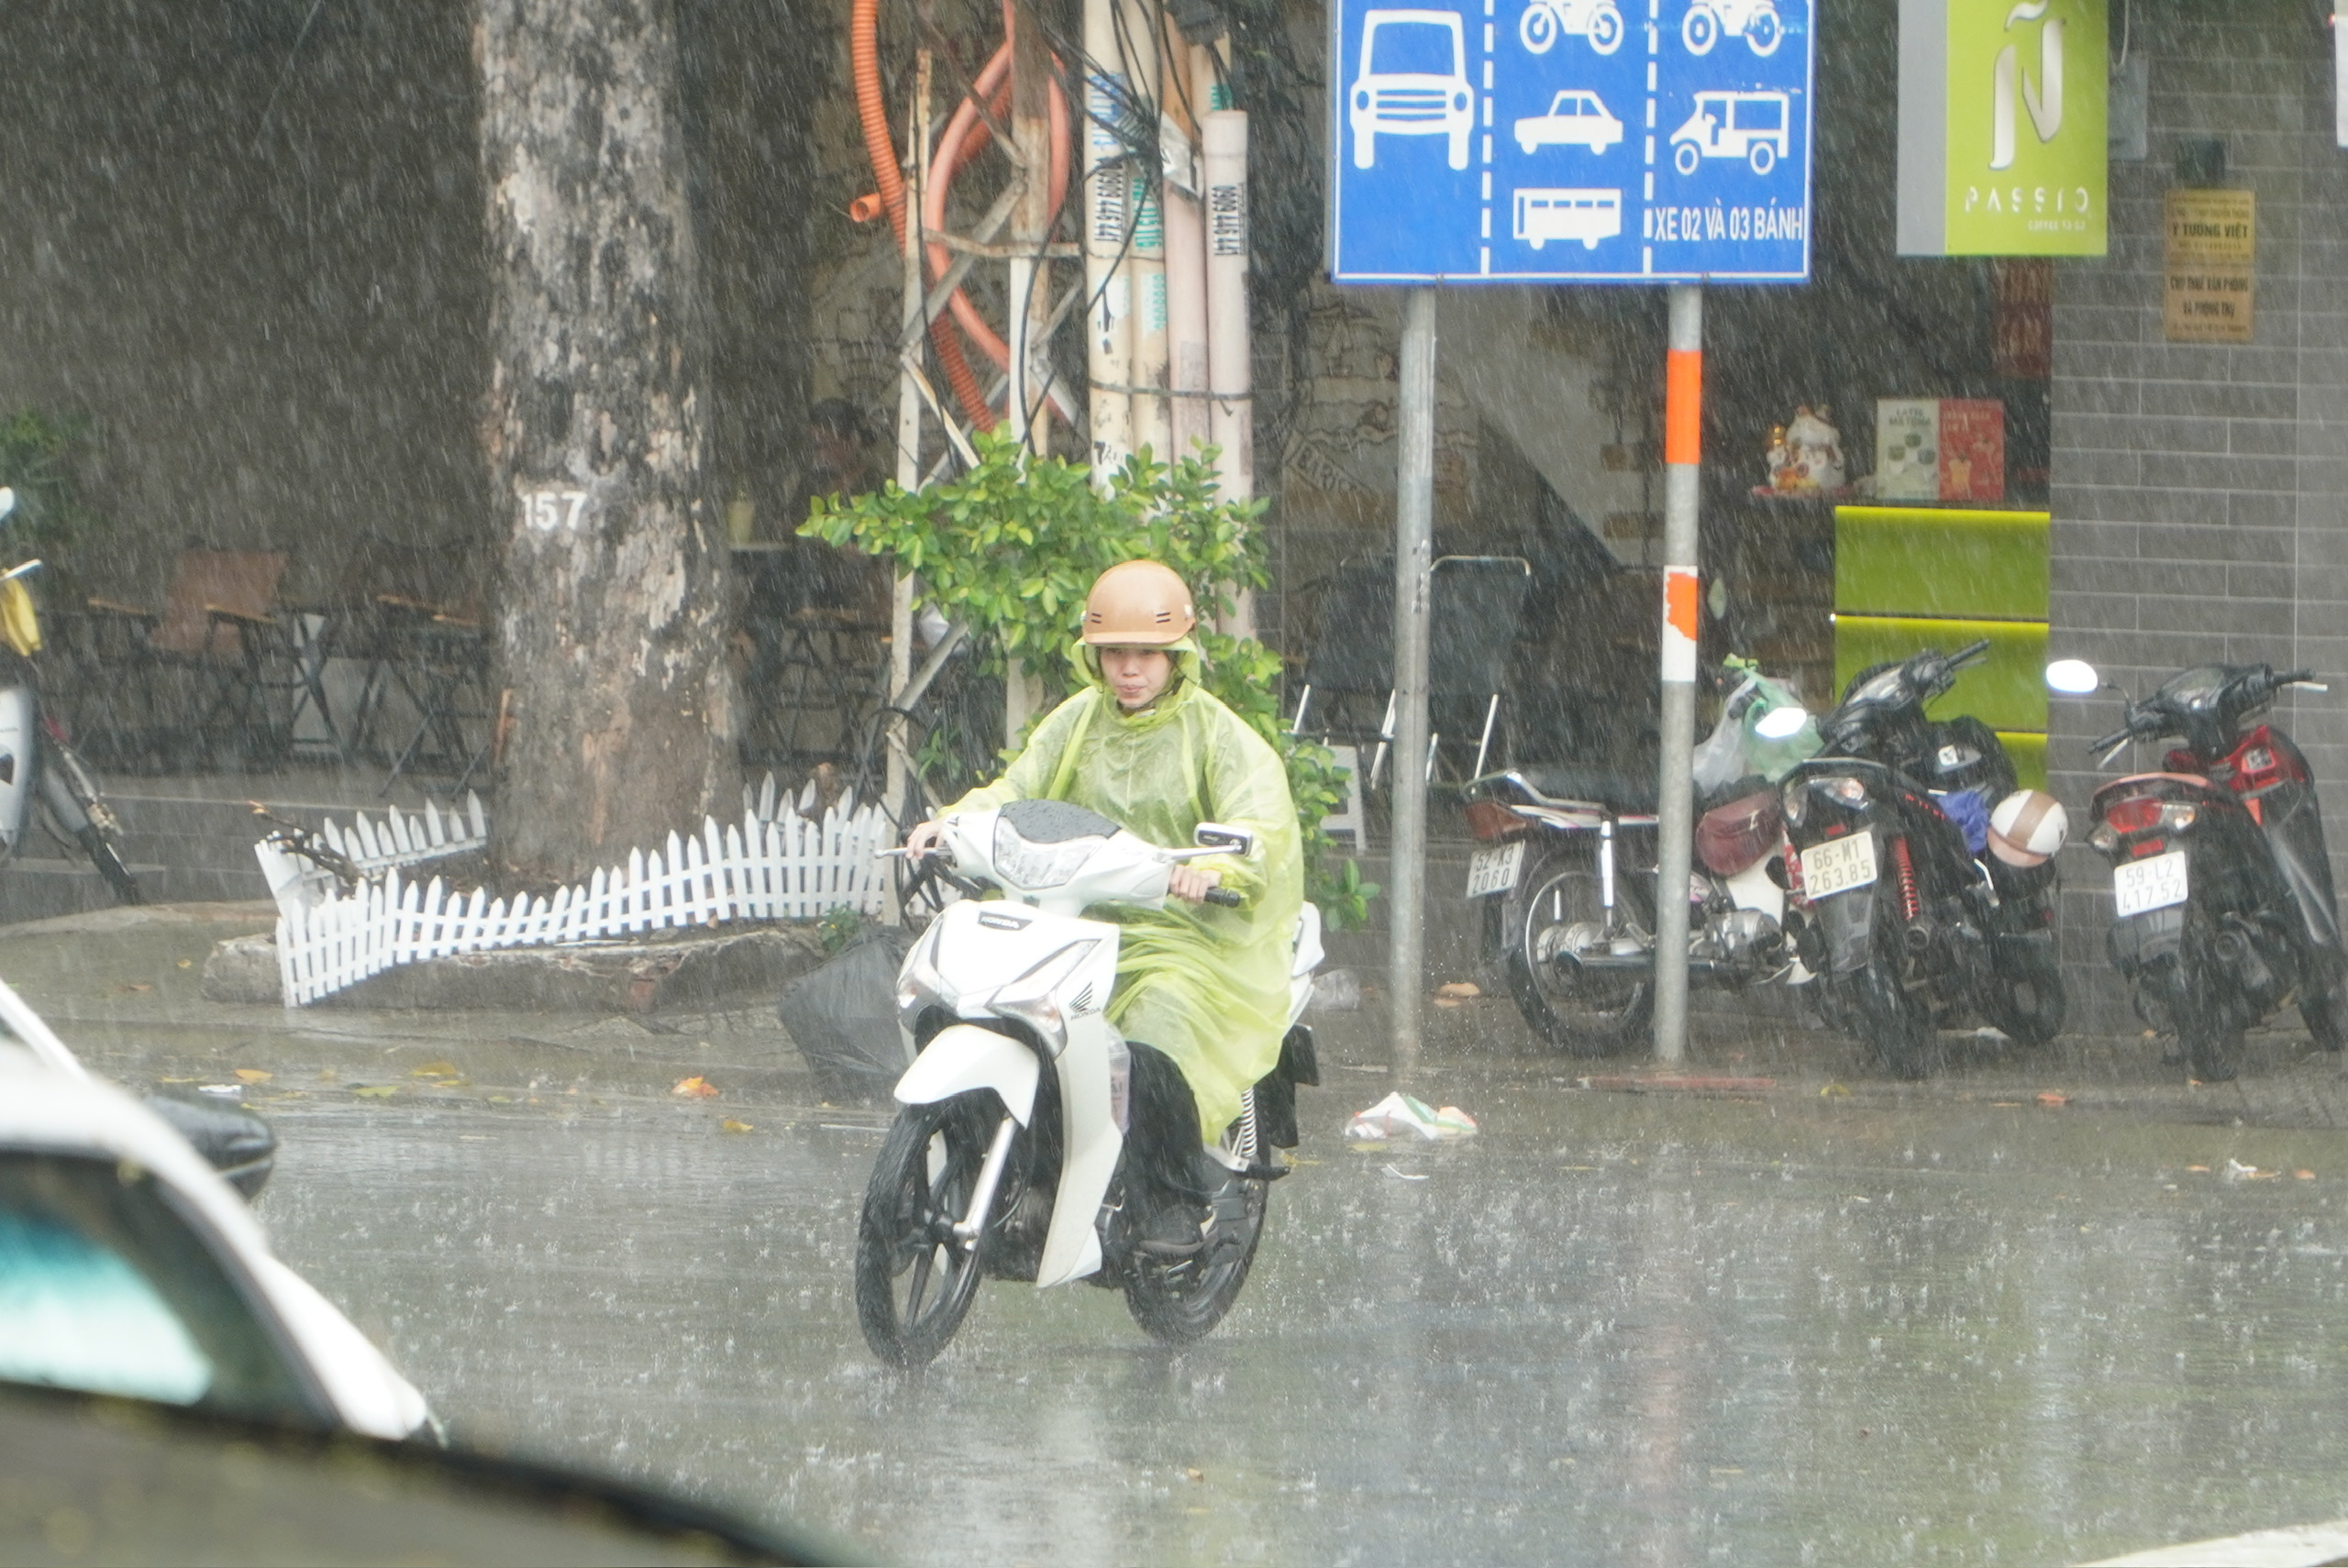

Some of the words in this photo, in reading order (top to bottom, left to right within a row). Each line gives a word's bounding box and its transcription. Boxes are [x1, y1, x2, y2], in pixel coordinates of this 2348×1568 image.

[1965, 186, 2089, 213] PASSIO
[1655, 207, 1678, 241] XE
[1681, 207, 1701, 241] 02
[1705, 196, 1726, 240] VÀ
[1730, 206, 1750, 240] 03
[1754, 196, 1804, 240] BÁNH
[522, 491, 588, 531] 157
[1813, 839, 1859, 870] 66-M1
[1472, 867, 1510, 894] 2060
[1810, 859, 1871, 896] 263.85
[1070, 1007, 1102, 1021] HONDA
